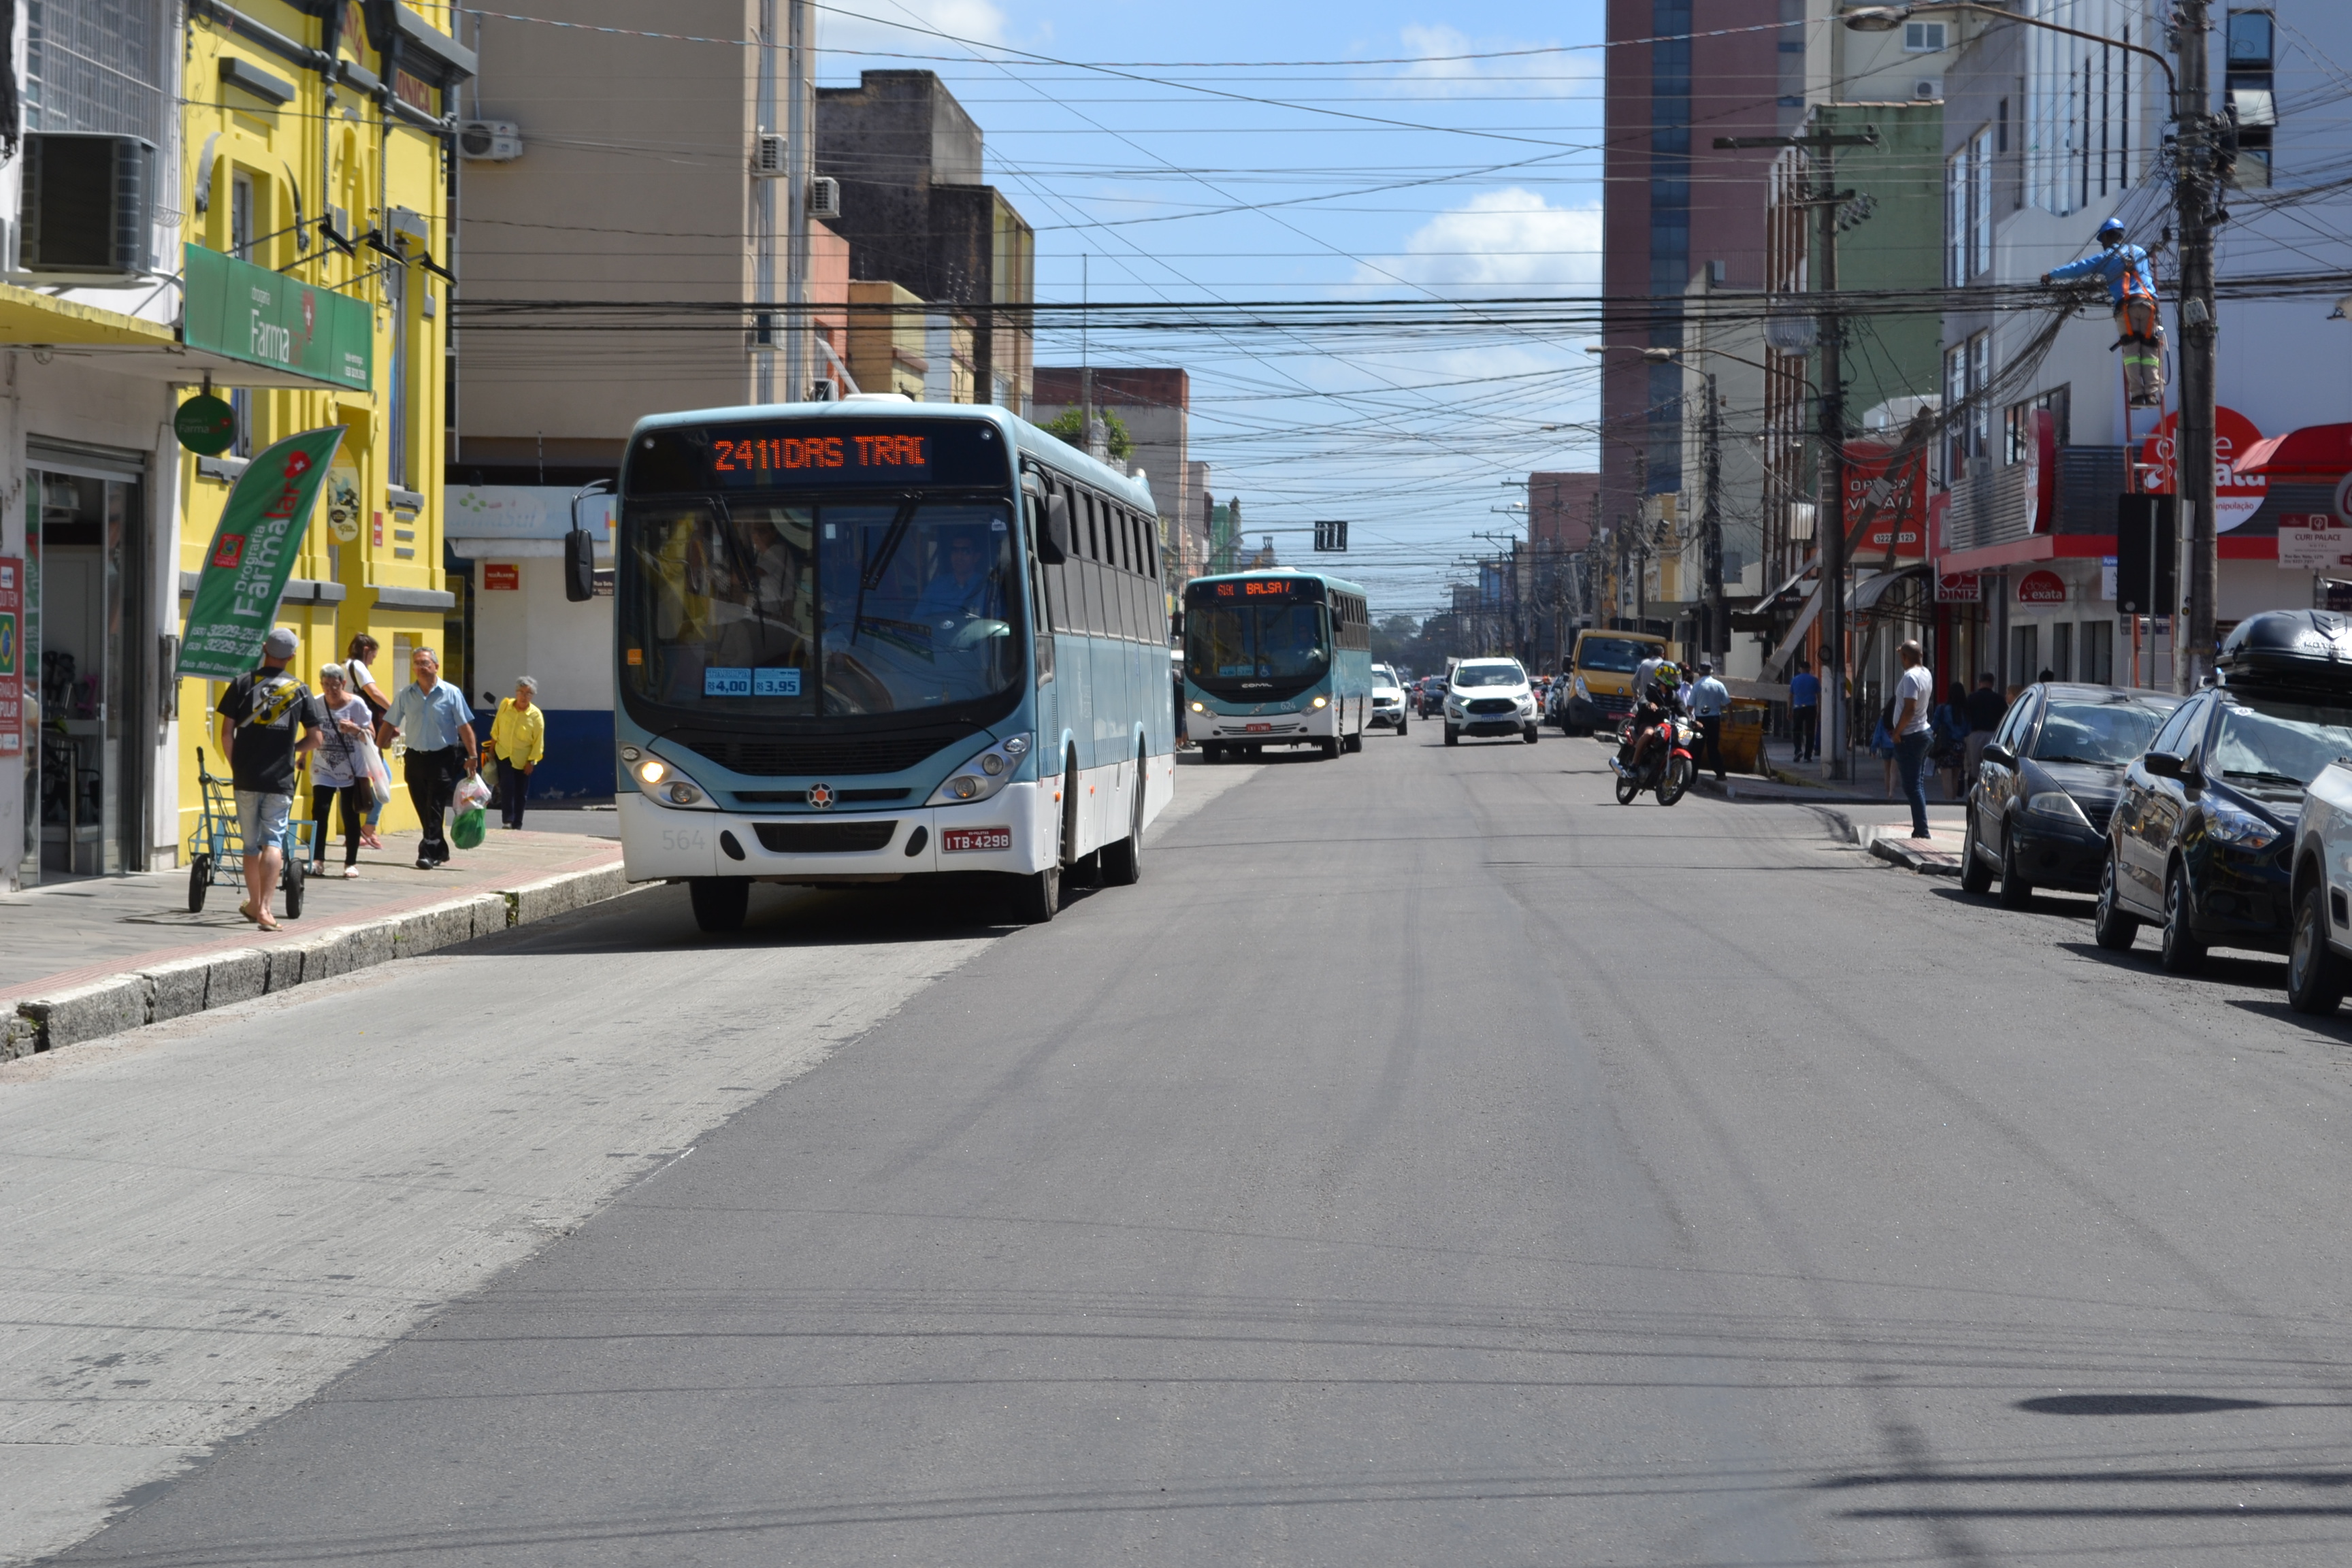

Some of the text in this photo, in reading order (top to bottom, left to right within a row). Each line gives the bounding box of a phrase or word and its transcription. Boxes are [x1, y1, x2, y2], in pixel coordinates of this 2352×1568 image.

[1246, 582, 1282, 594] BALSA
[2025, 580, 2053, 591] dose
[1939, 590, 1978, 600] DINIZ
[2031, 590, 2063, 600] exata
[716, 680, 747, 693] 4,00
[765, 680, 796, 693] 3,95
[1280, 702, 1296, 711] 624
[662, 830, 706, 851] 564
